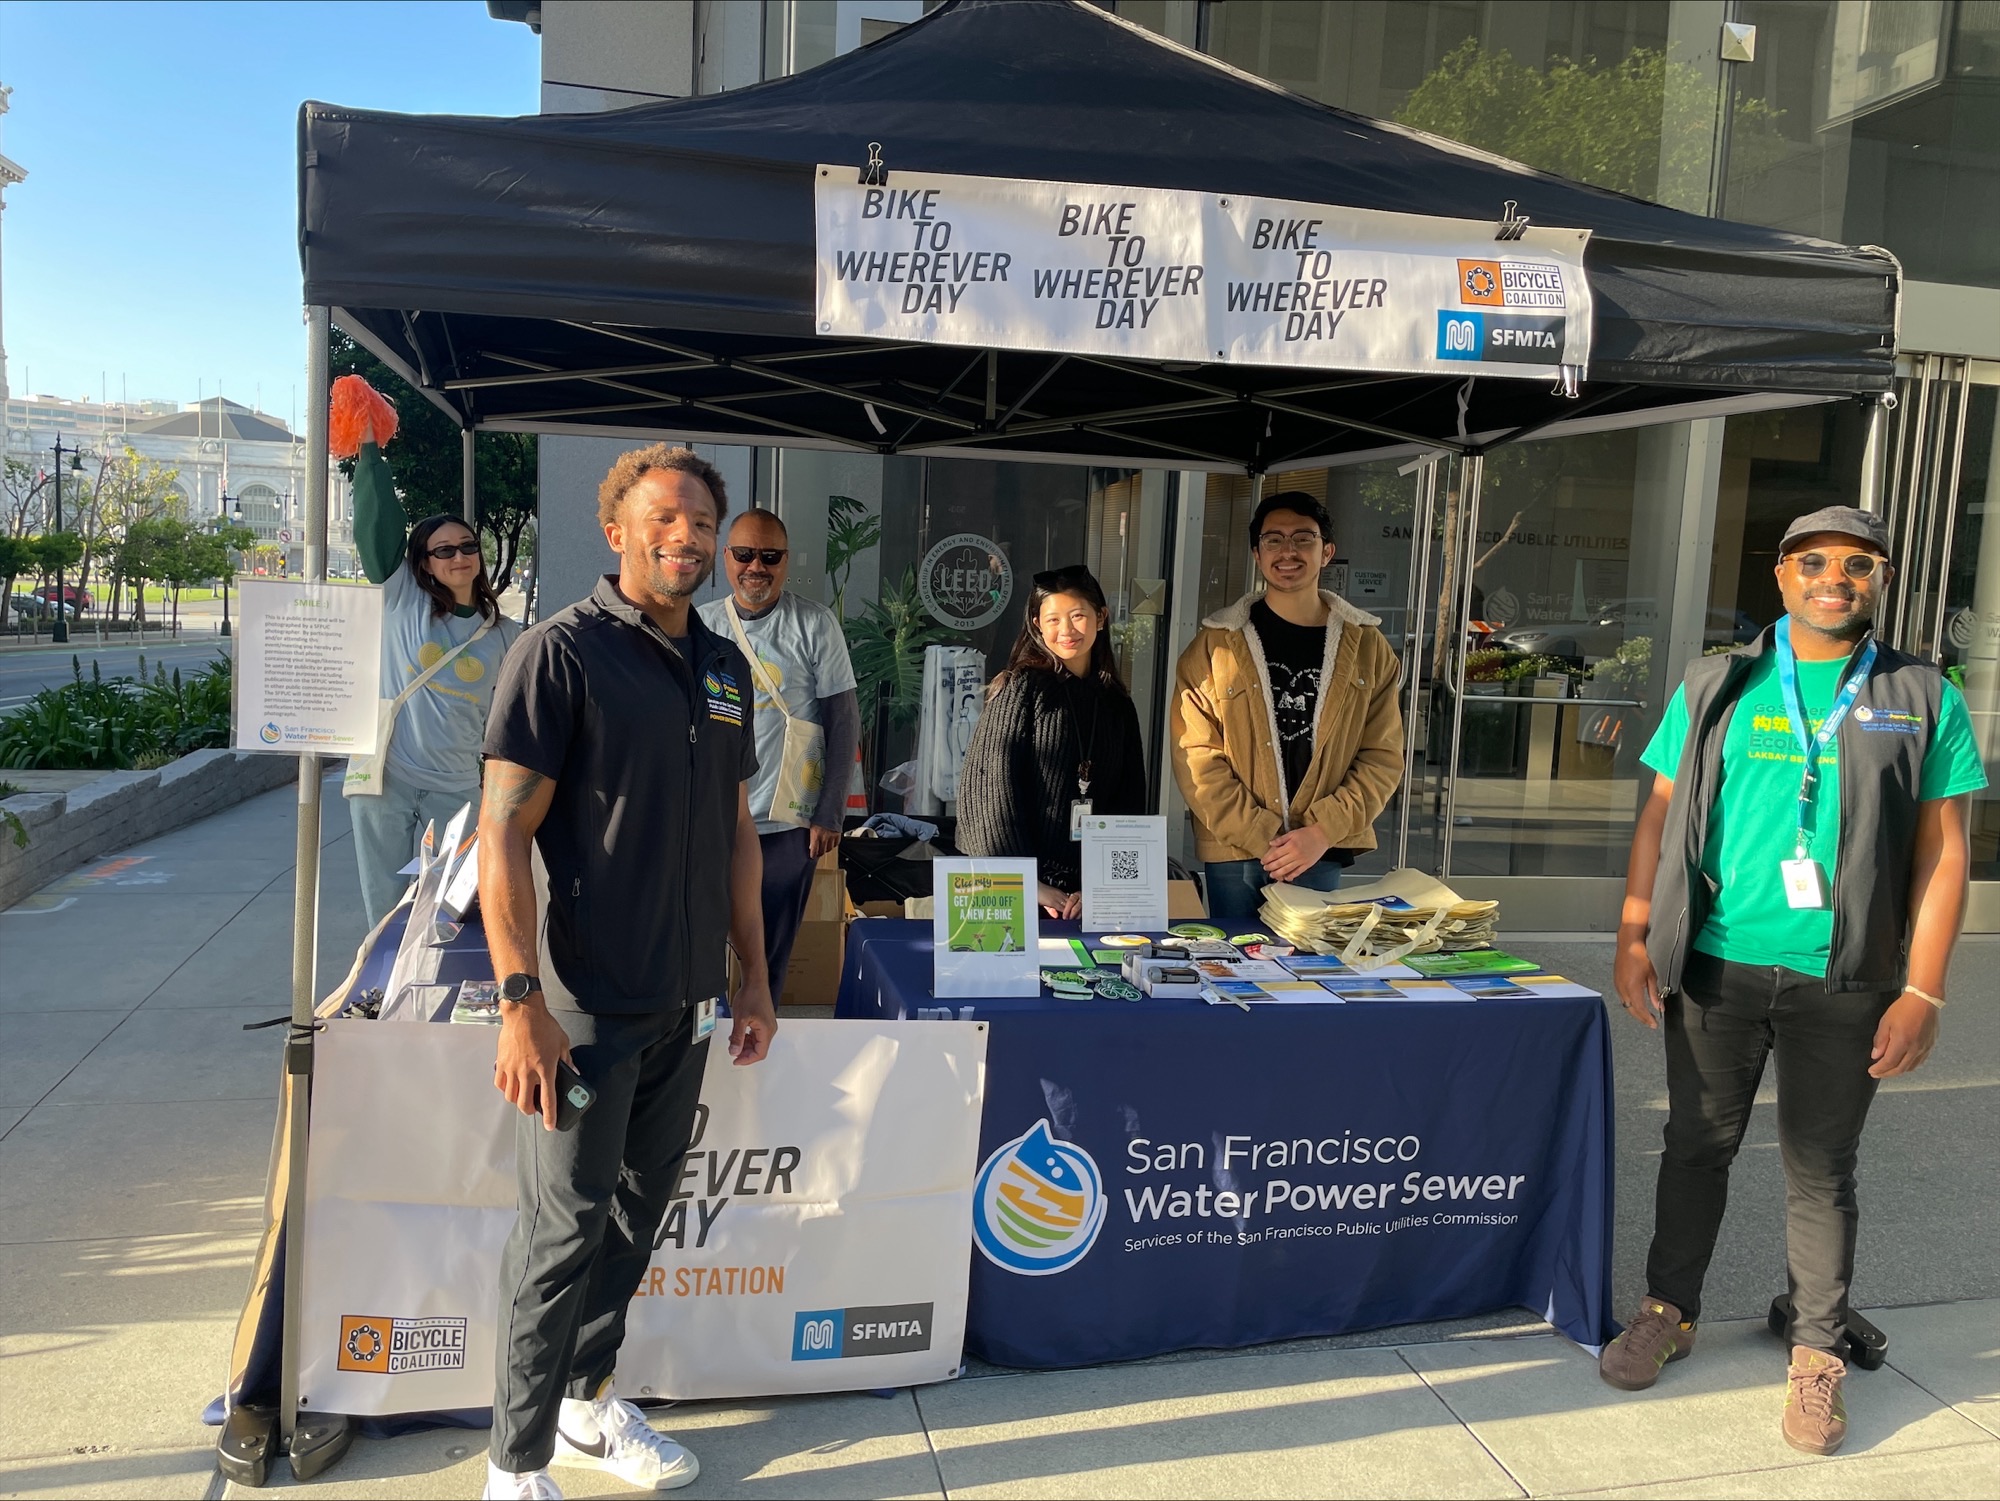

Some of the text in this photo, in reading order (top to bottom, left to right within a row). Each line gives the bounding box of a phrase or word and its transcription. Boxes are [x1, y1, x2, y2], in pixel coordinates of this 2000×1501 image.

[862, 189, 939, 220] BIKE
[1059, 204, 1135, 236] BIKE
[1252, 219, 1322, 250] BIKE
[912, 221, 951, 251] TO
[836, 251, 1010, 283] WHEREVER
[1108, 237, 1145, 268] TO
[1296, 251, 1331, 280] TO
[1033, 266, 1203, 298] WHEREVER
[1504, 272, 1560, 289] BICYCLE
[902, 284, 968, 314] DAY
[1227, 279, 1388, 312] WHEREVER
[1506, 292, 1562, 305] COALITION
[1096, 299, 1160, 330] DAY
[1285, 311, 1344, 342] DAY
[1492, 328, 1556, 348] SFMTA
[1382, 526, 1412, 539] SAN
[1509, 533, 1559, 546] PUBLIC
[1564, 536, 1629, 550] UTILITIES
[926, 558, 933, 568] IN
[932, 539, 956, 558] ENERGY
[942, 569, 991, 592] LEED
[294, 599, 329, 609] SMILE :)
[1528, 592, 1552, 605] San
[1527, 608, 1568, 620] Water
[1754, 704, 1776, 712] Go
[1748, 751, 1787, 761] LAKBAY
[954, 877, 992, 888] Elecrify
[954, 896, 968, 906] GET
[960, 909, 1012, 920] A NEW E-BIKE
[1126, 1130, 1420, 1174] San Francisco
[1124, 1172, 1525, 1223] Water Power Sewer
[652, 1198, 729, 1250] AY
[1125, 1210, 1518, 1252] Services of the San Francisco Public Utilities Commission
[674, 1266, 784, 1296] STATION
[393, 1329, 461, 1350] BICYCLE
[852, 1320, 922, 1340] SFMTA
[391, 1353, 460, 1370] COALITION
